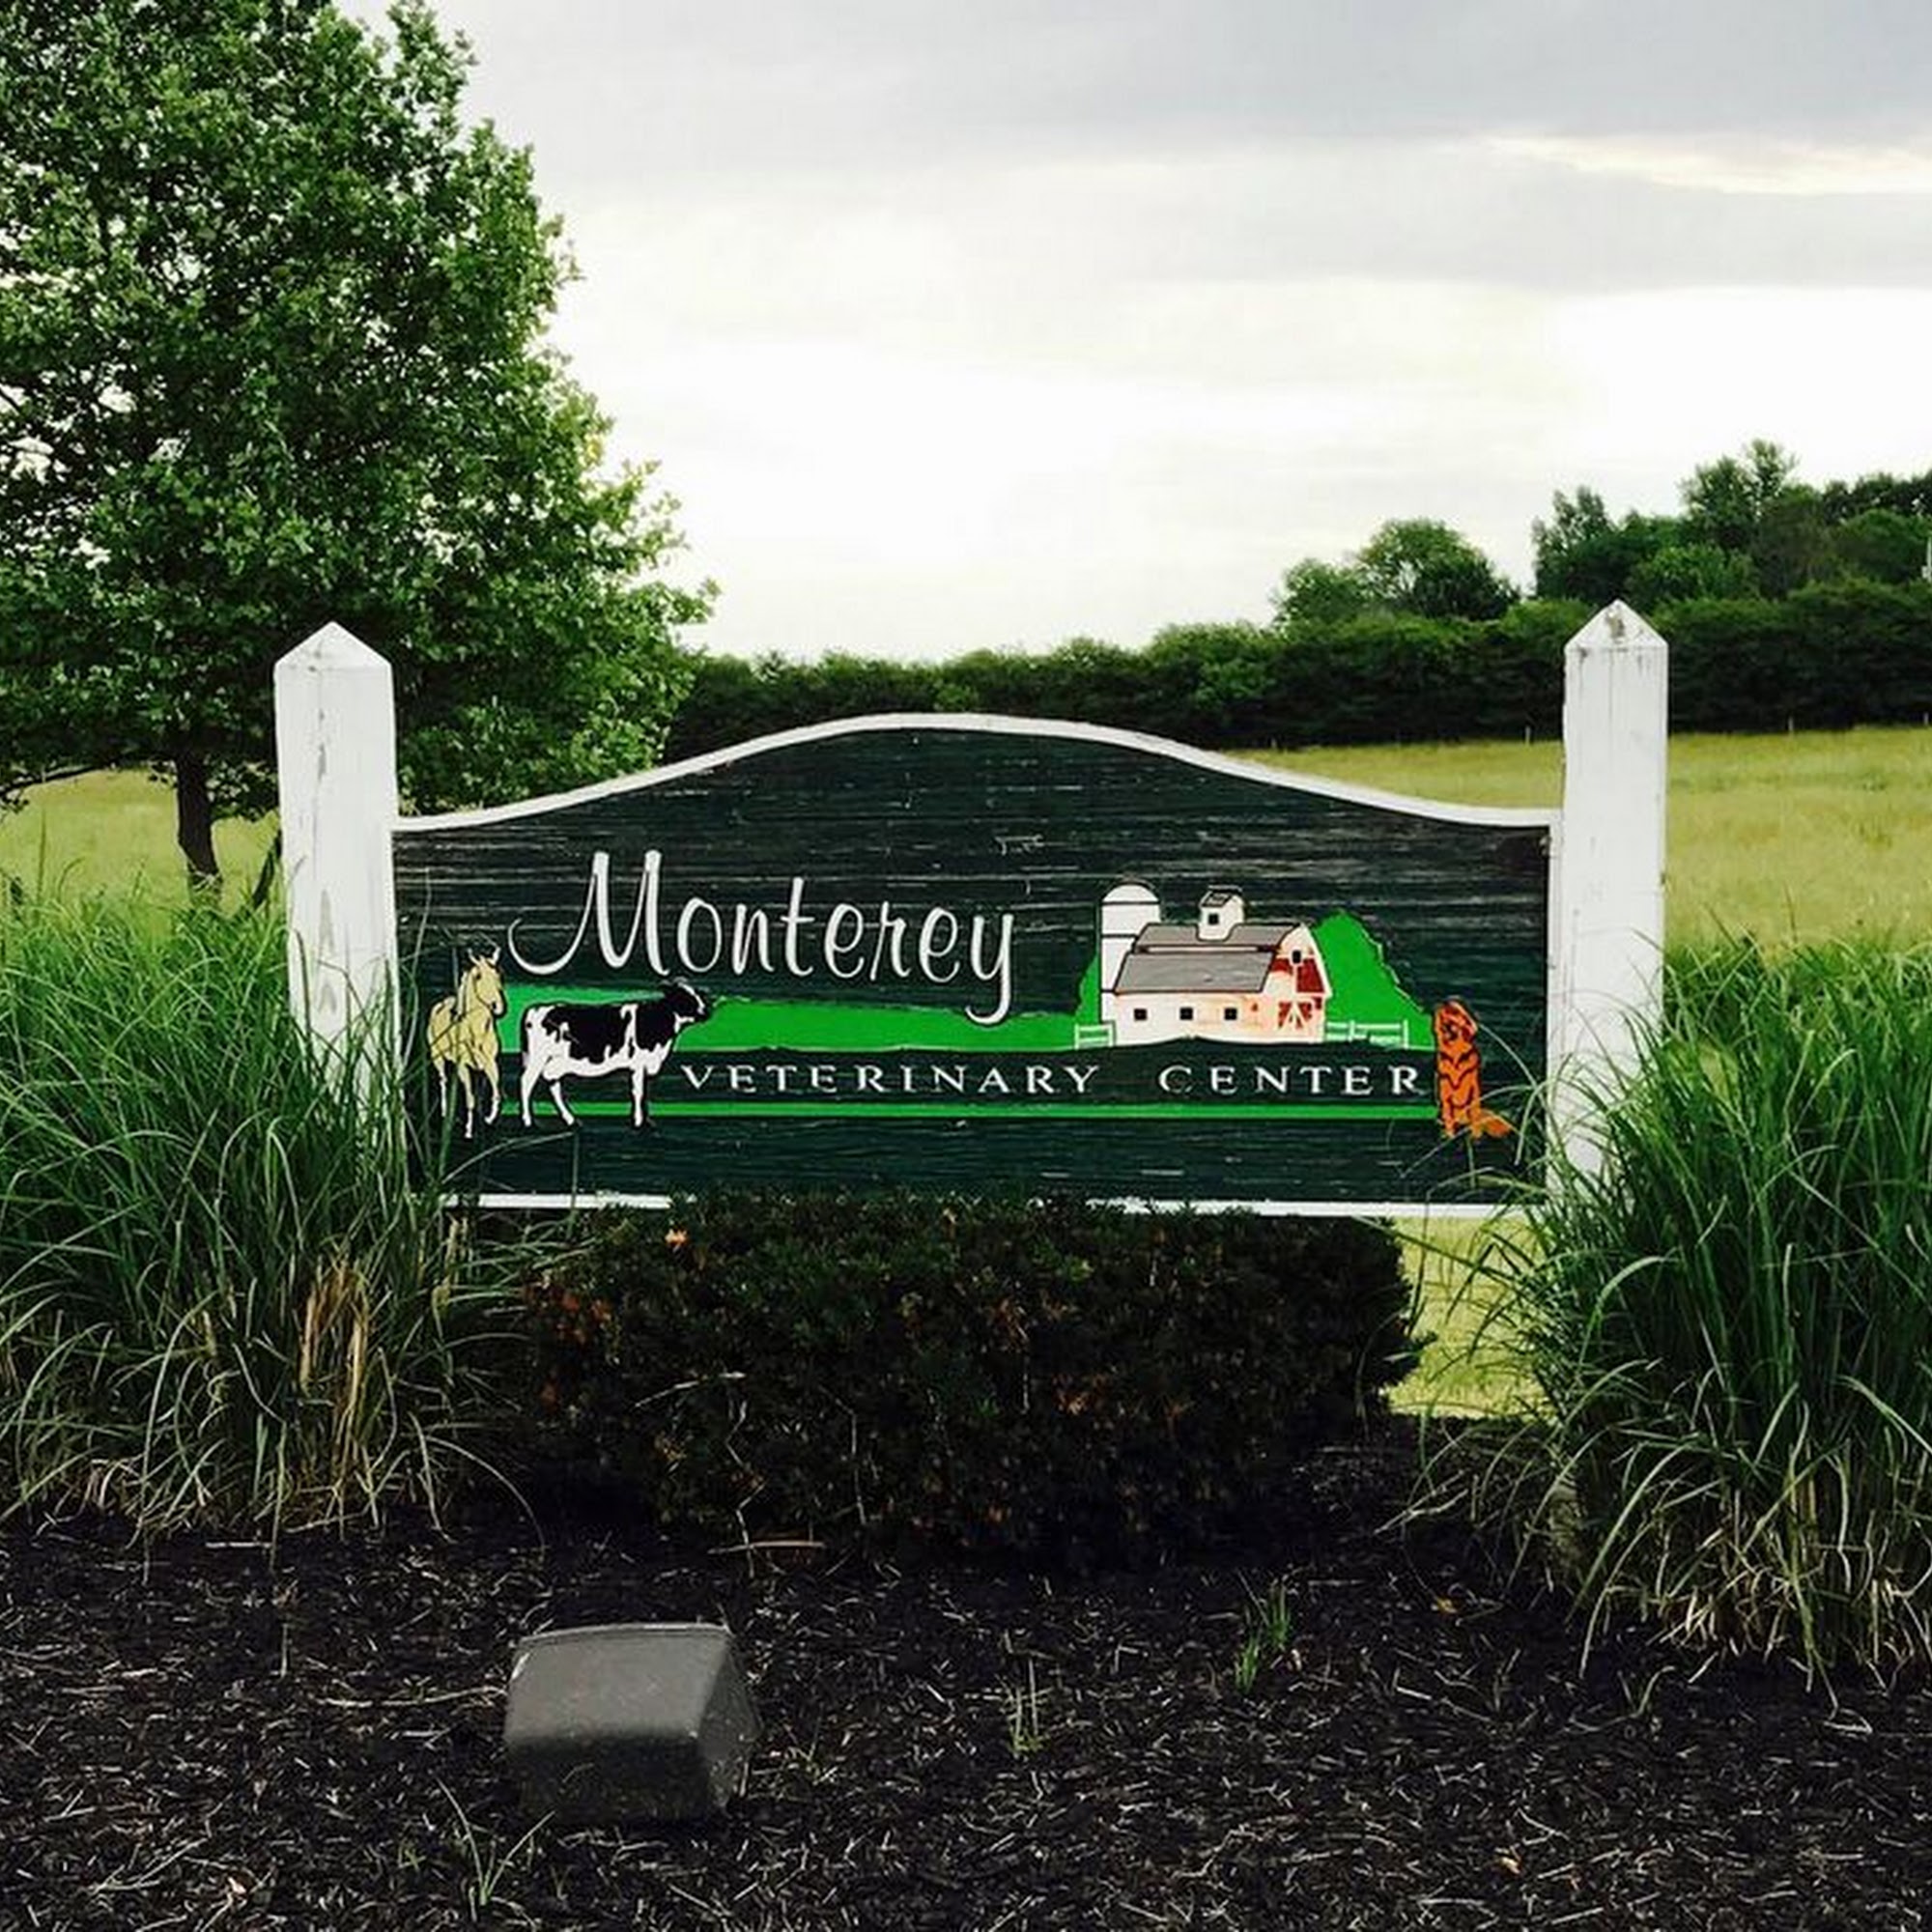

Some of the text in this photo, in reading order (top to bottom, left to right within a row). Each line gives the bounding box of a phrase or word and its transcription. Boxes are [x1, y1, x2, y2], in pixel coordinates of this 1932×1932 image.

[507, 849, 1014, 1025] Monterey
[679, 1063, 1426, 1096] VETERINARY CENTER
